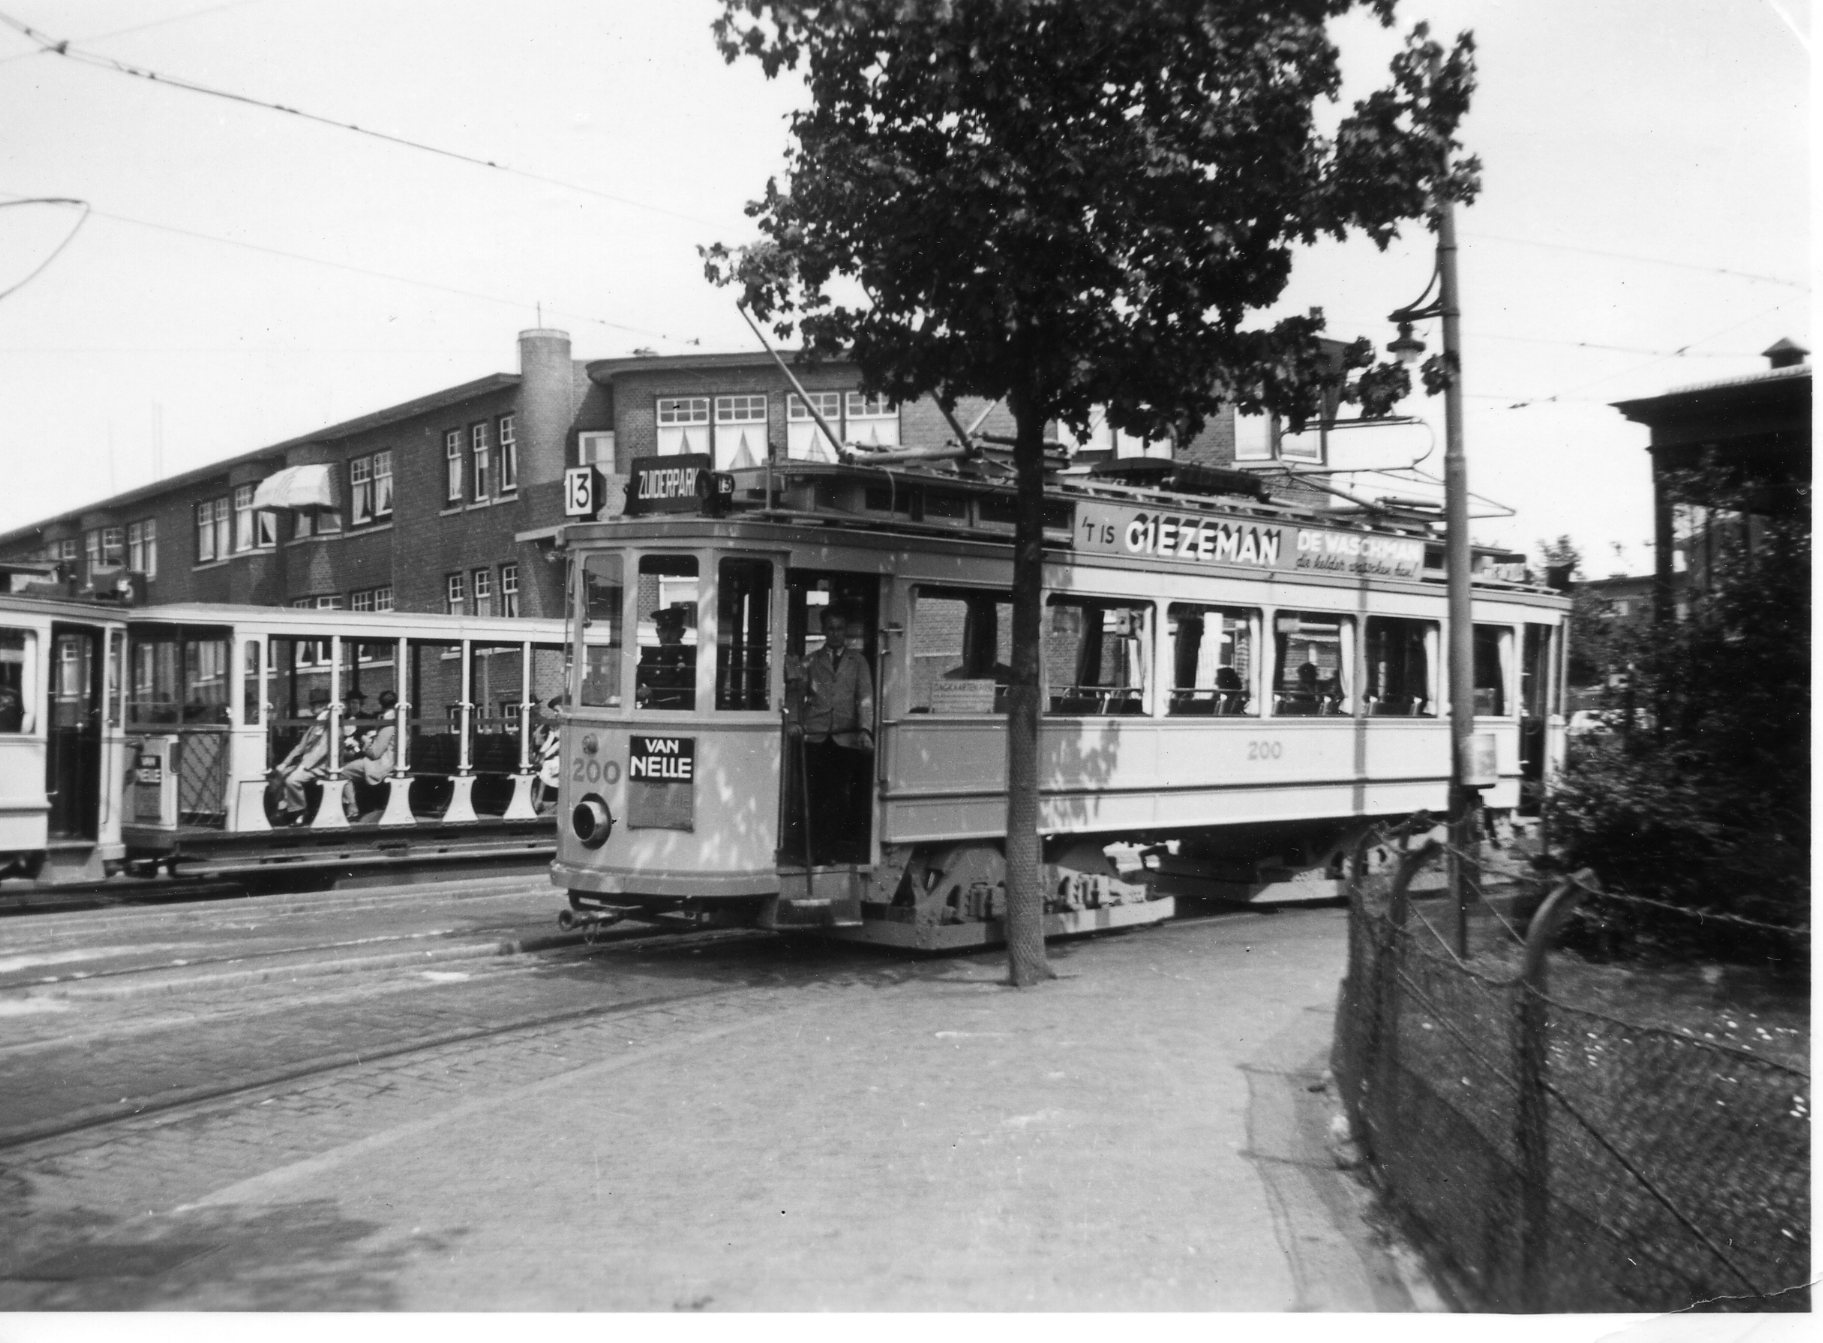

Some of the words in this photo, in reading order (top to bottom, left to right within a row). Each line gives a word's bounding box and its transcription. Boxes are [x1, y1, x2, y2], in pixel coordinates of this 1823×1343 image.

[569, 473, 590, 509] 13
[1100, 525, 1115, 544] IS
[1124, 514, 1281, 566] GIEZEMAN
[1297, 531, 1322, 552] DE
[645, 738, 679, 754] VAN
[1247, 741, 1282, 760] 200
[572, 758, 620, 784] 200
[630, 755, 692, 779] NELLE
